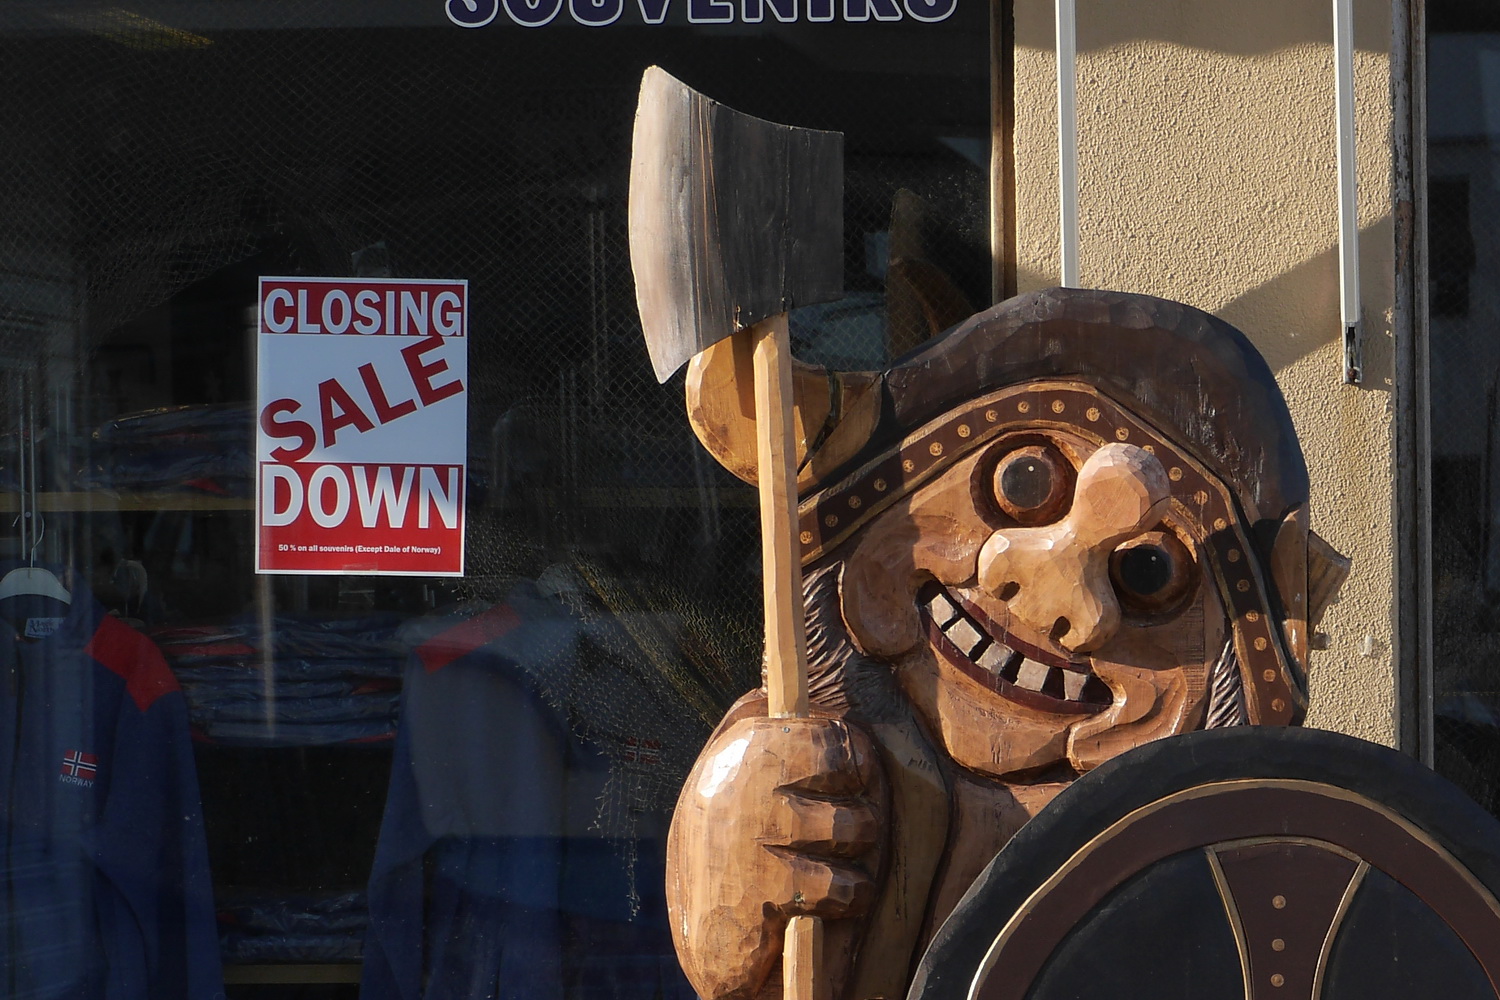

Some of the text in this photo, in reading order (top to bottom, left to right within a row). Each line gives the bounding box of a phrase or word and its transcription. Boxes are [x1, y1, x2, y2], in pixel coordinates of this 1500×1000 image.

[263, 288, 462, 336] CLOSING
[260, 336, 464, 463] SALE
[262, 465, 458, 529] DOWN
[278, 544, 288, 552] 50
[290, 544, 296, 552] %
[308, 544, 318, 552] all
[319, 545, 354, 553] souvenirs
[355, 545, 383, 554] (Except
[384, 545, 401, 553] Dale
[402, 545, 410, 553] of
[411, 545, 441, 555] Norway)
[59, 774, 94, 789] NORWAY
